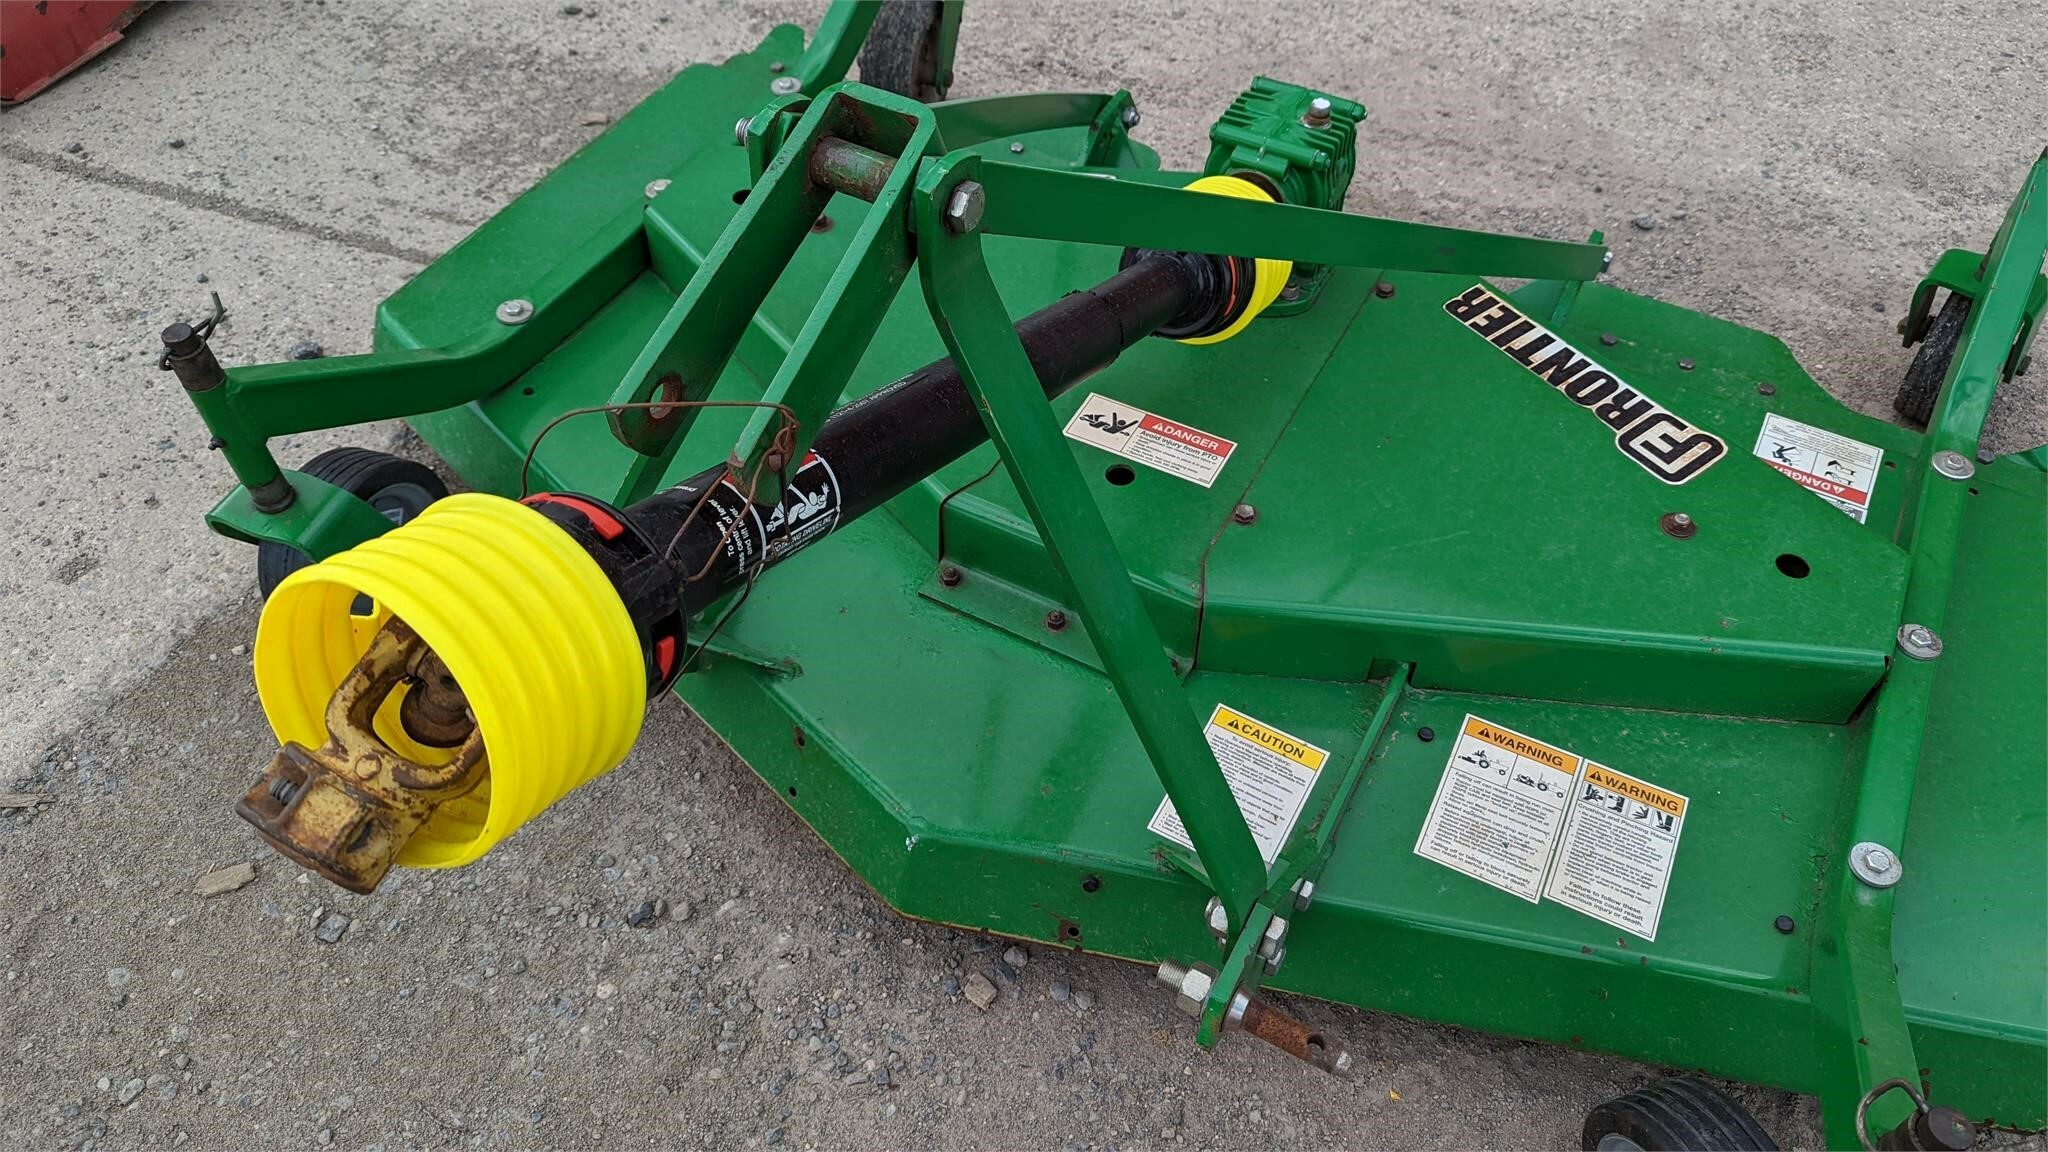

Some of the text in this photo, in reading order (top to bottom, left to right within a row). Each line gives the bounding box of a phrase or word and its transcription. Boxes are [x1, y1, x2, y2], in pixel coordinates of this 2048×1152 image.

[1445, 286, 1725, 482] FRONTIER
[1140, 429, 1161, 440] Avoid
[1160, 437, 1182, 448] injury
[1182, 445, 1201, 454] from
[1201, 451, 1218, 460] PTO
[1163, 426, 1219, 449] DANGER
[1774, 466, 1831, 490] DANGE
[728, 545, 734, 557] To
[1241, 723, 1305, 759] CAUTION
[1493, 732, 1563, 767] WARNING
[1605, 775, 1678, 811] WARNING
